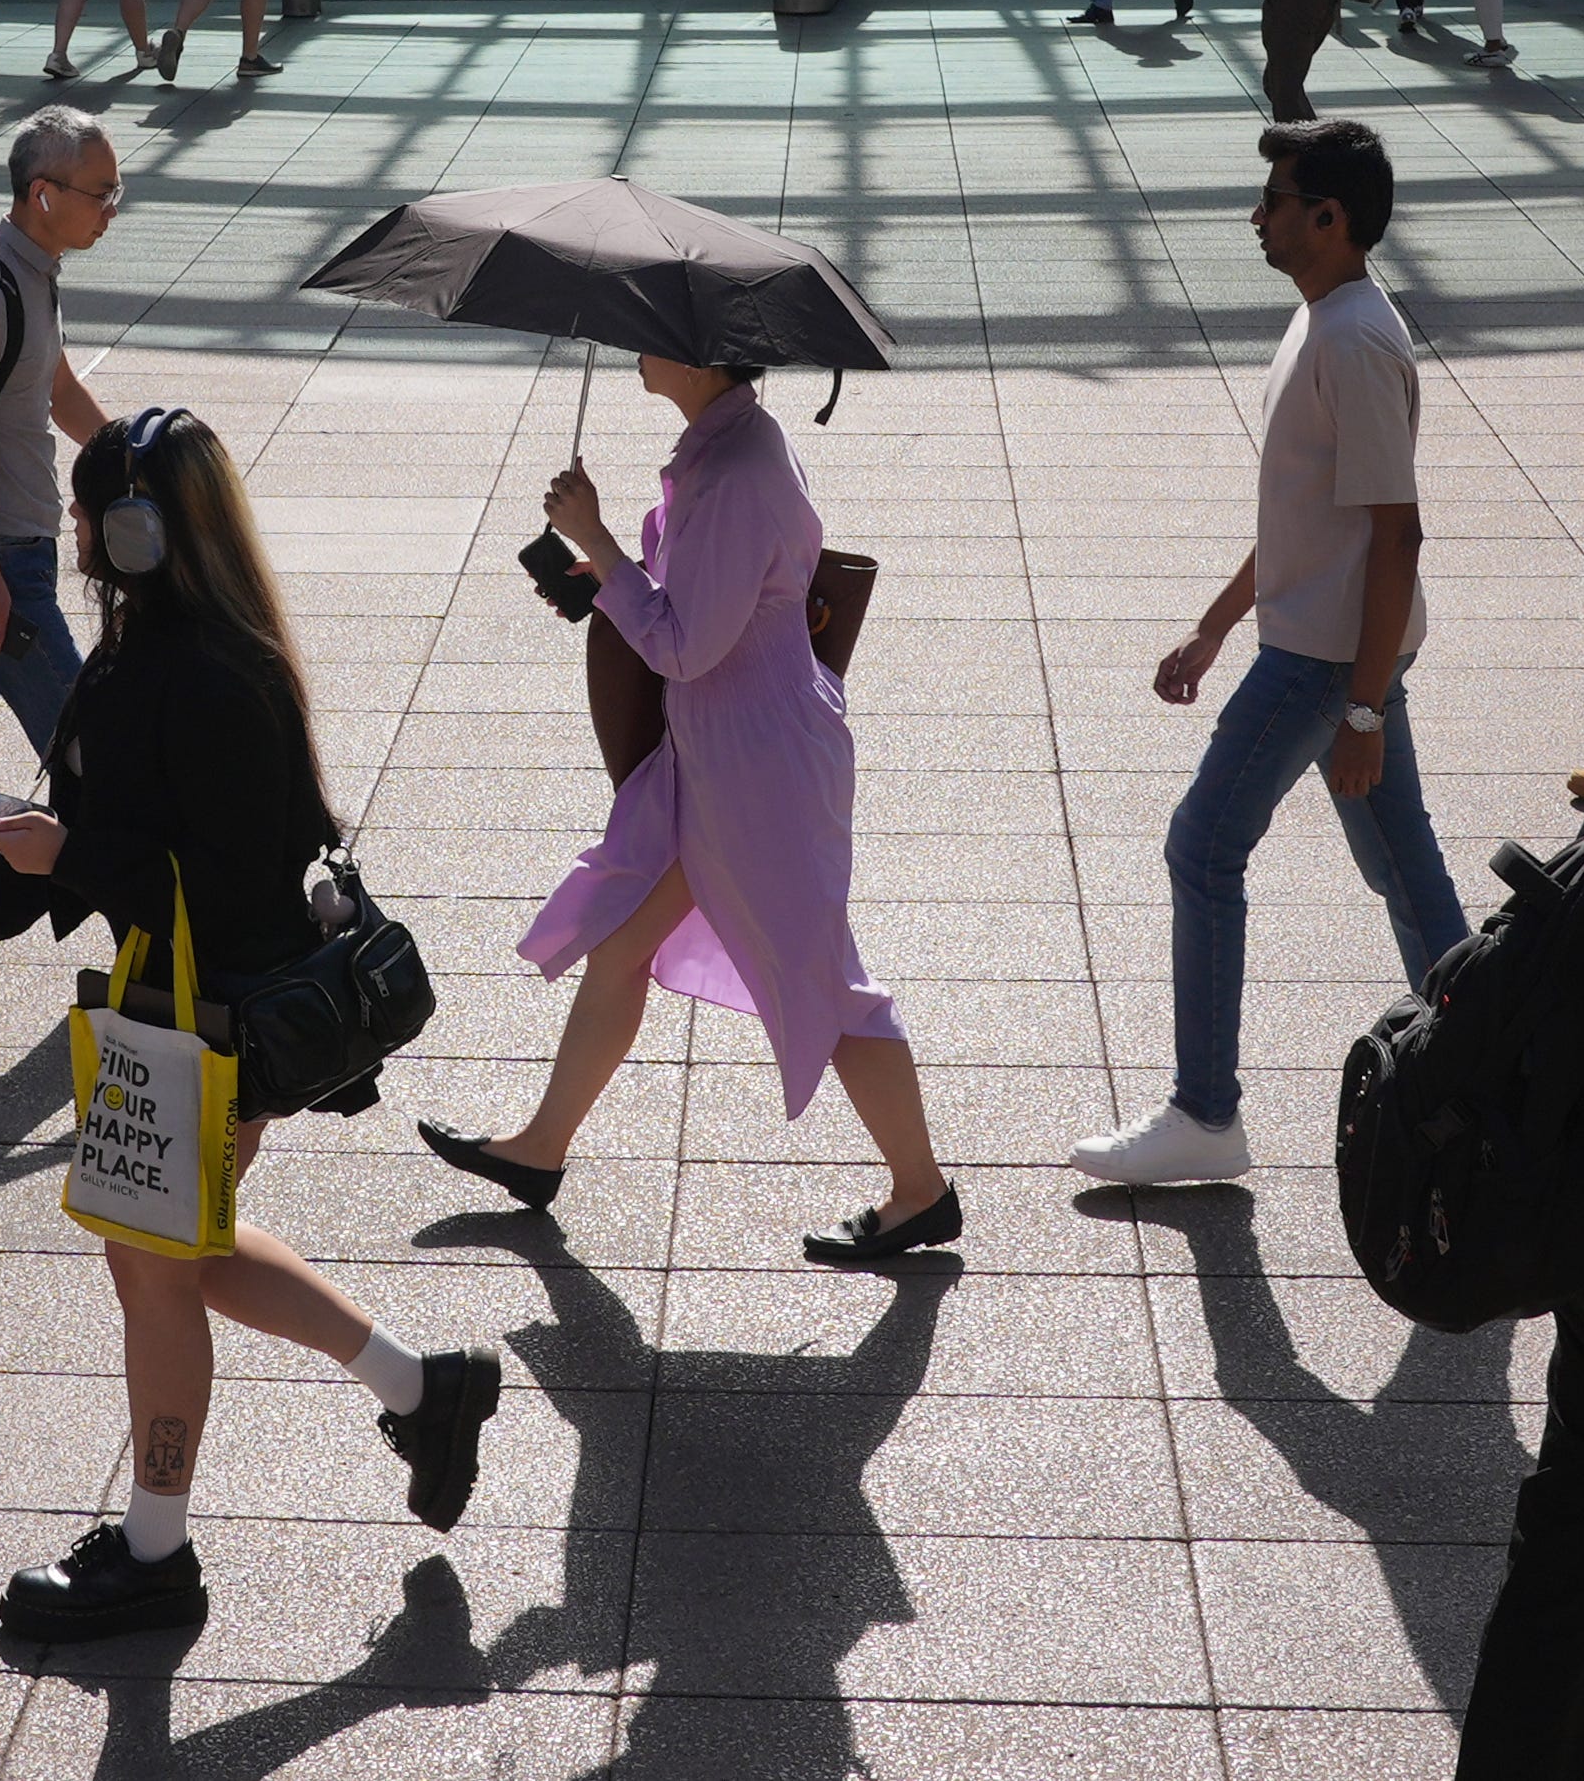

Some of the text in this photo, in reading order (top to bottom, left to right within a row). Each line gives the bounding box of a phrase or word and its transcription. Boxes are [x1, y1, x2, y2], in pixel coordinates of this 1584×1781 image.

[101, 1047, 150, 1087] FIND
[93, 1080, 157, 1124] YOUR
[85, 1111, 174, 1160] HAPPY
[80, 1172, 140, 1201] GILLY HICKS
[81, 1143, 170, 1195] PLACE.
[217, 1098, 239, 1230] GILLYHICKS.COM
